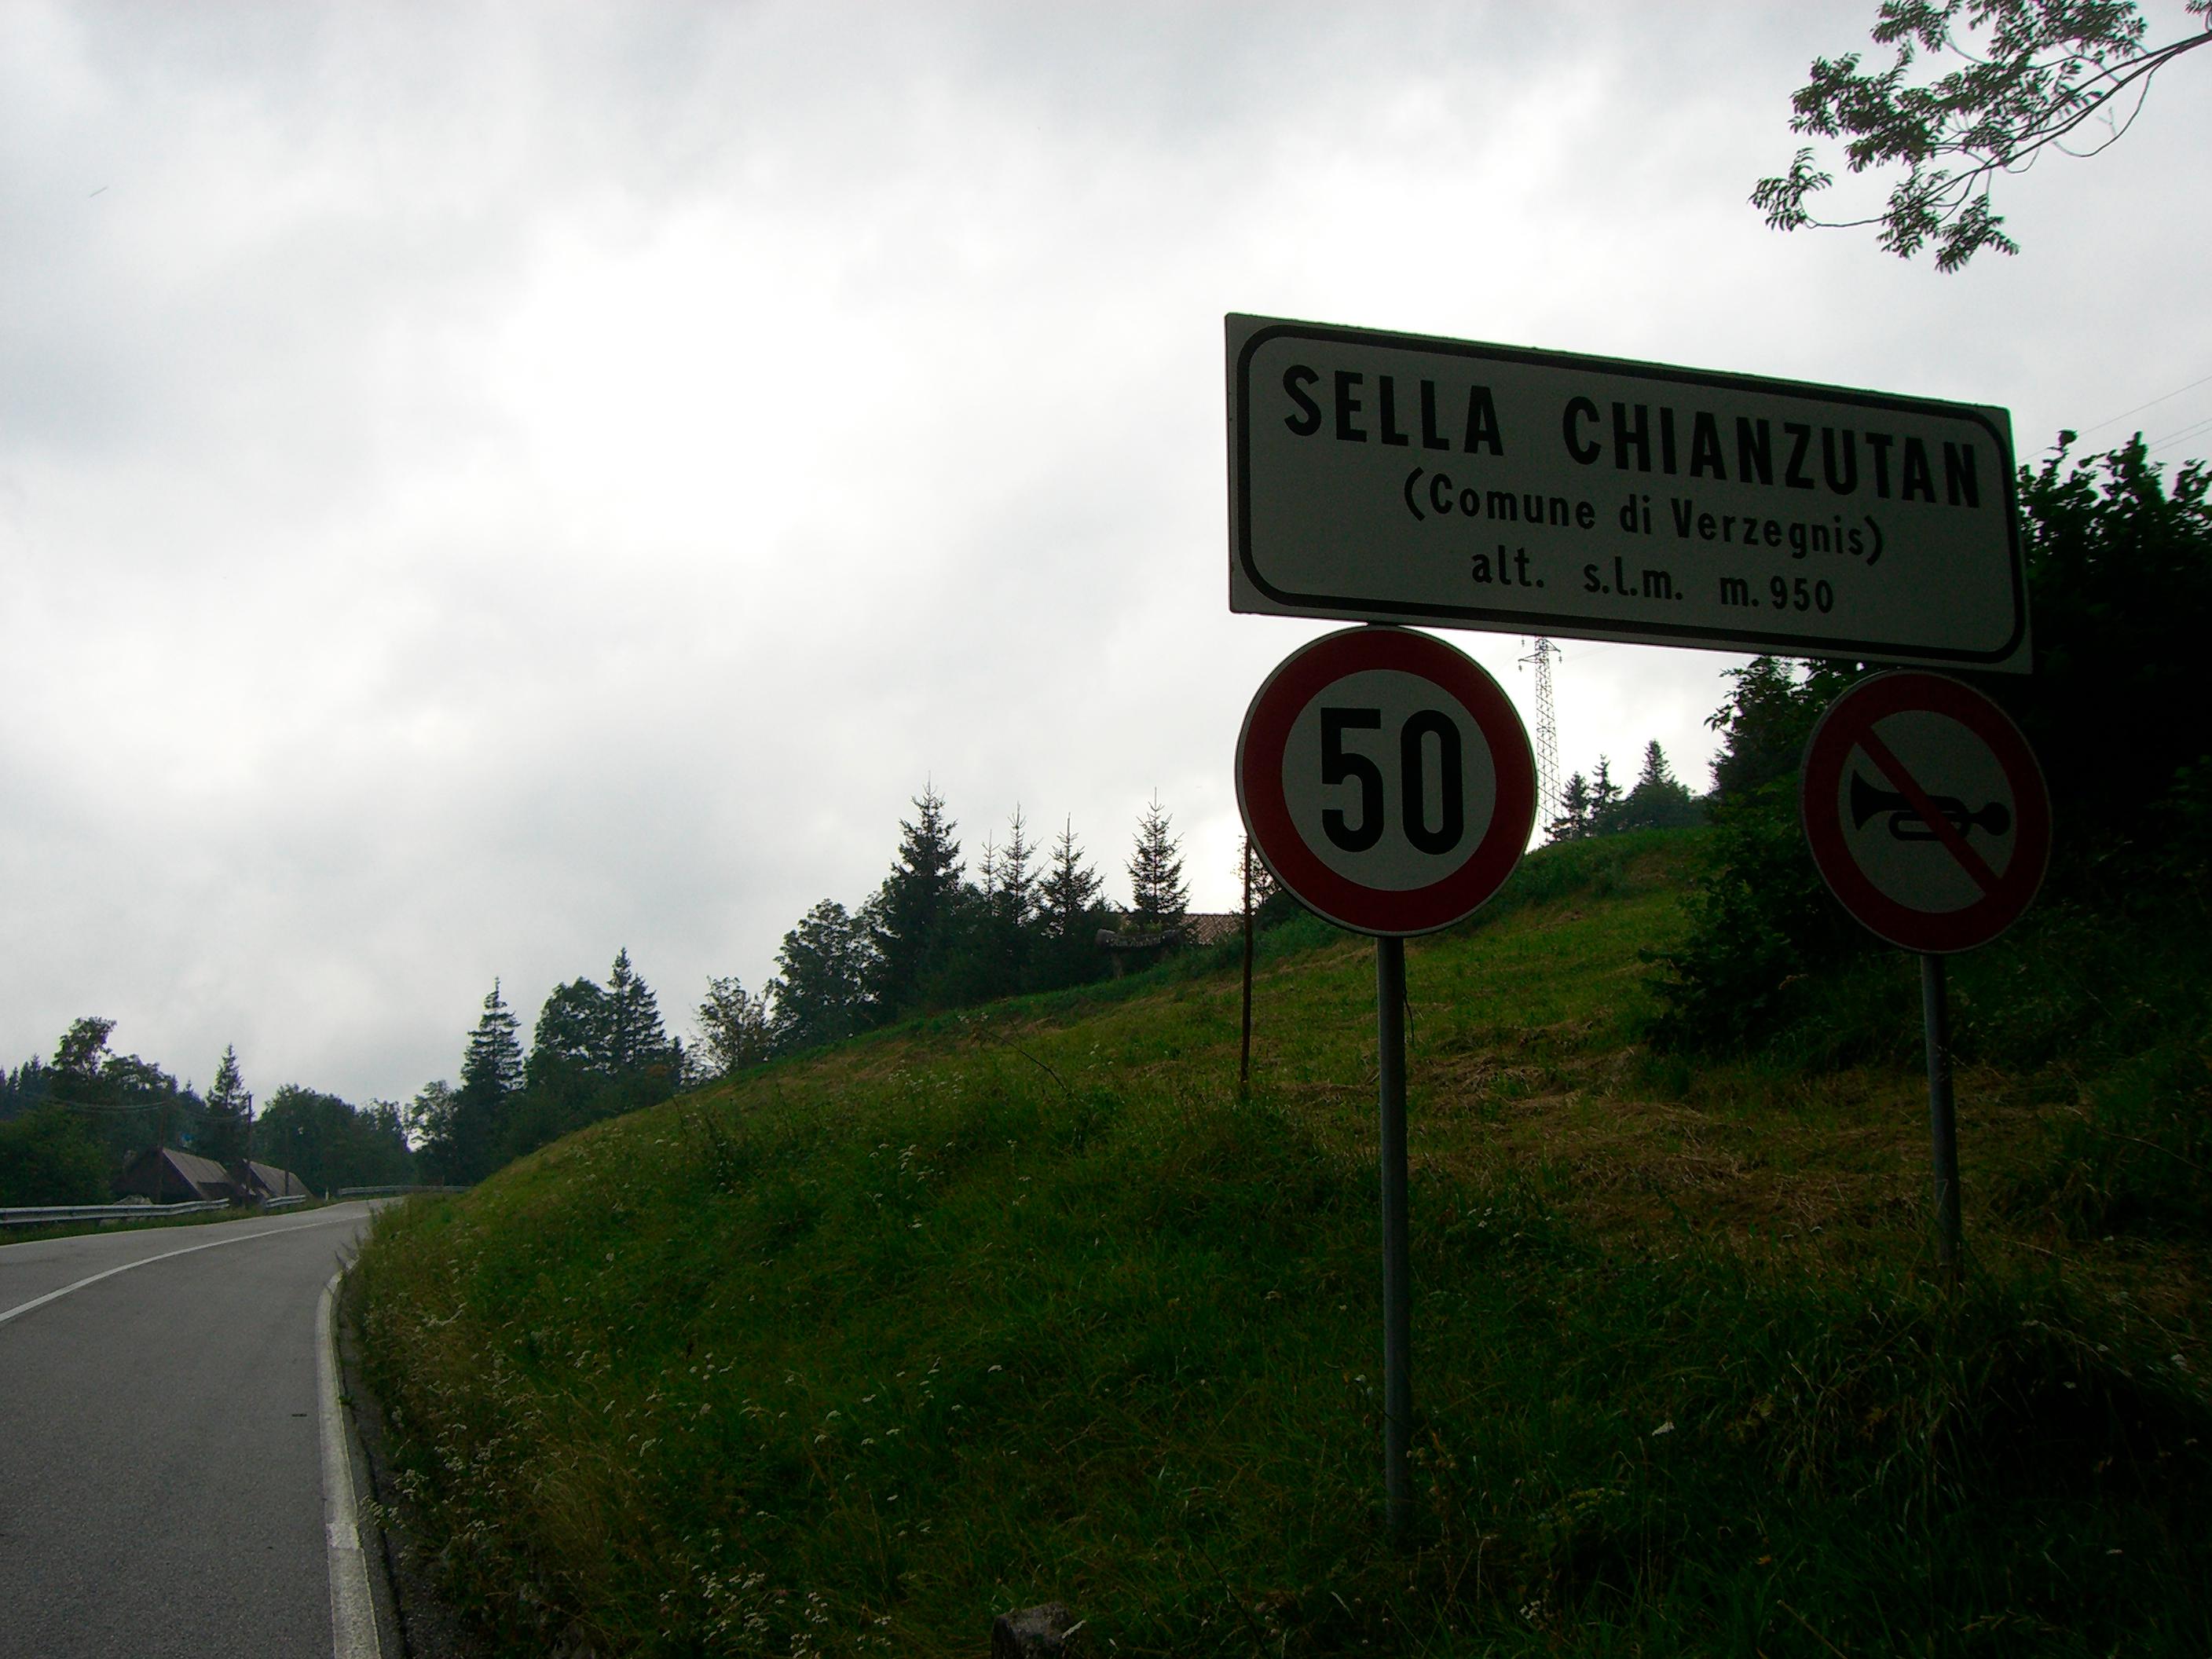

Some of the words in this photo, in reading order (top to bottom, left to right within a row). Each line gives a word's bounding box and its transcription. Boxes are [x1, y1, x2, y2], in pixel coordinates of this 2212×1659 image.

[1283, 364, 1504, 456] SELLA
[1562, 396, 1981, 509] CHIANZUTAN
[1404, 467, 1595, 530] (Comune
[1619, 493, 1652, 535] di
[1670, 497, 1885, 567] Verzegnis)
[1471, 544, 1544, 588] alt.
[1584, 555, 1683, 605] s.l.m.
[1320, 707, 1464, 855] 50
